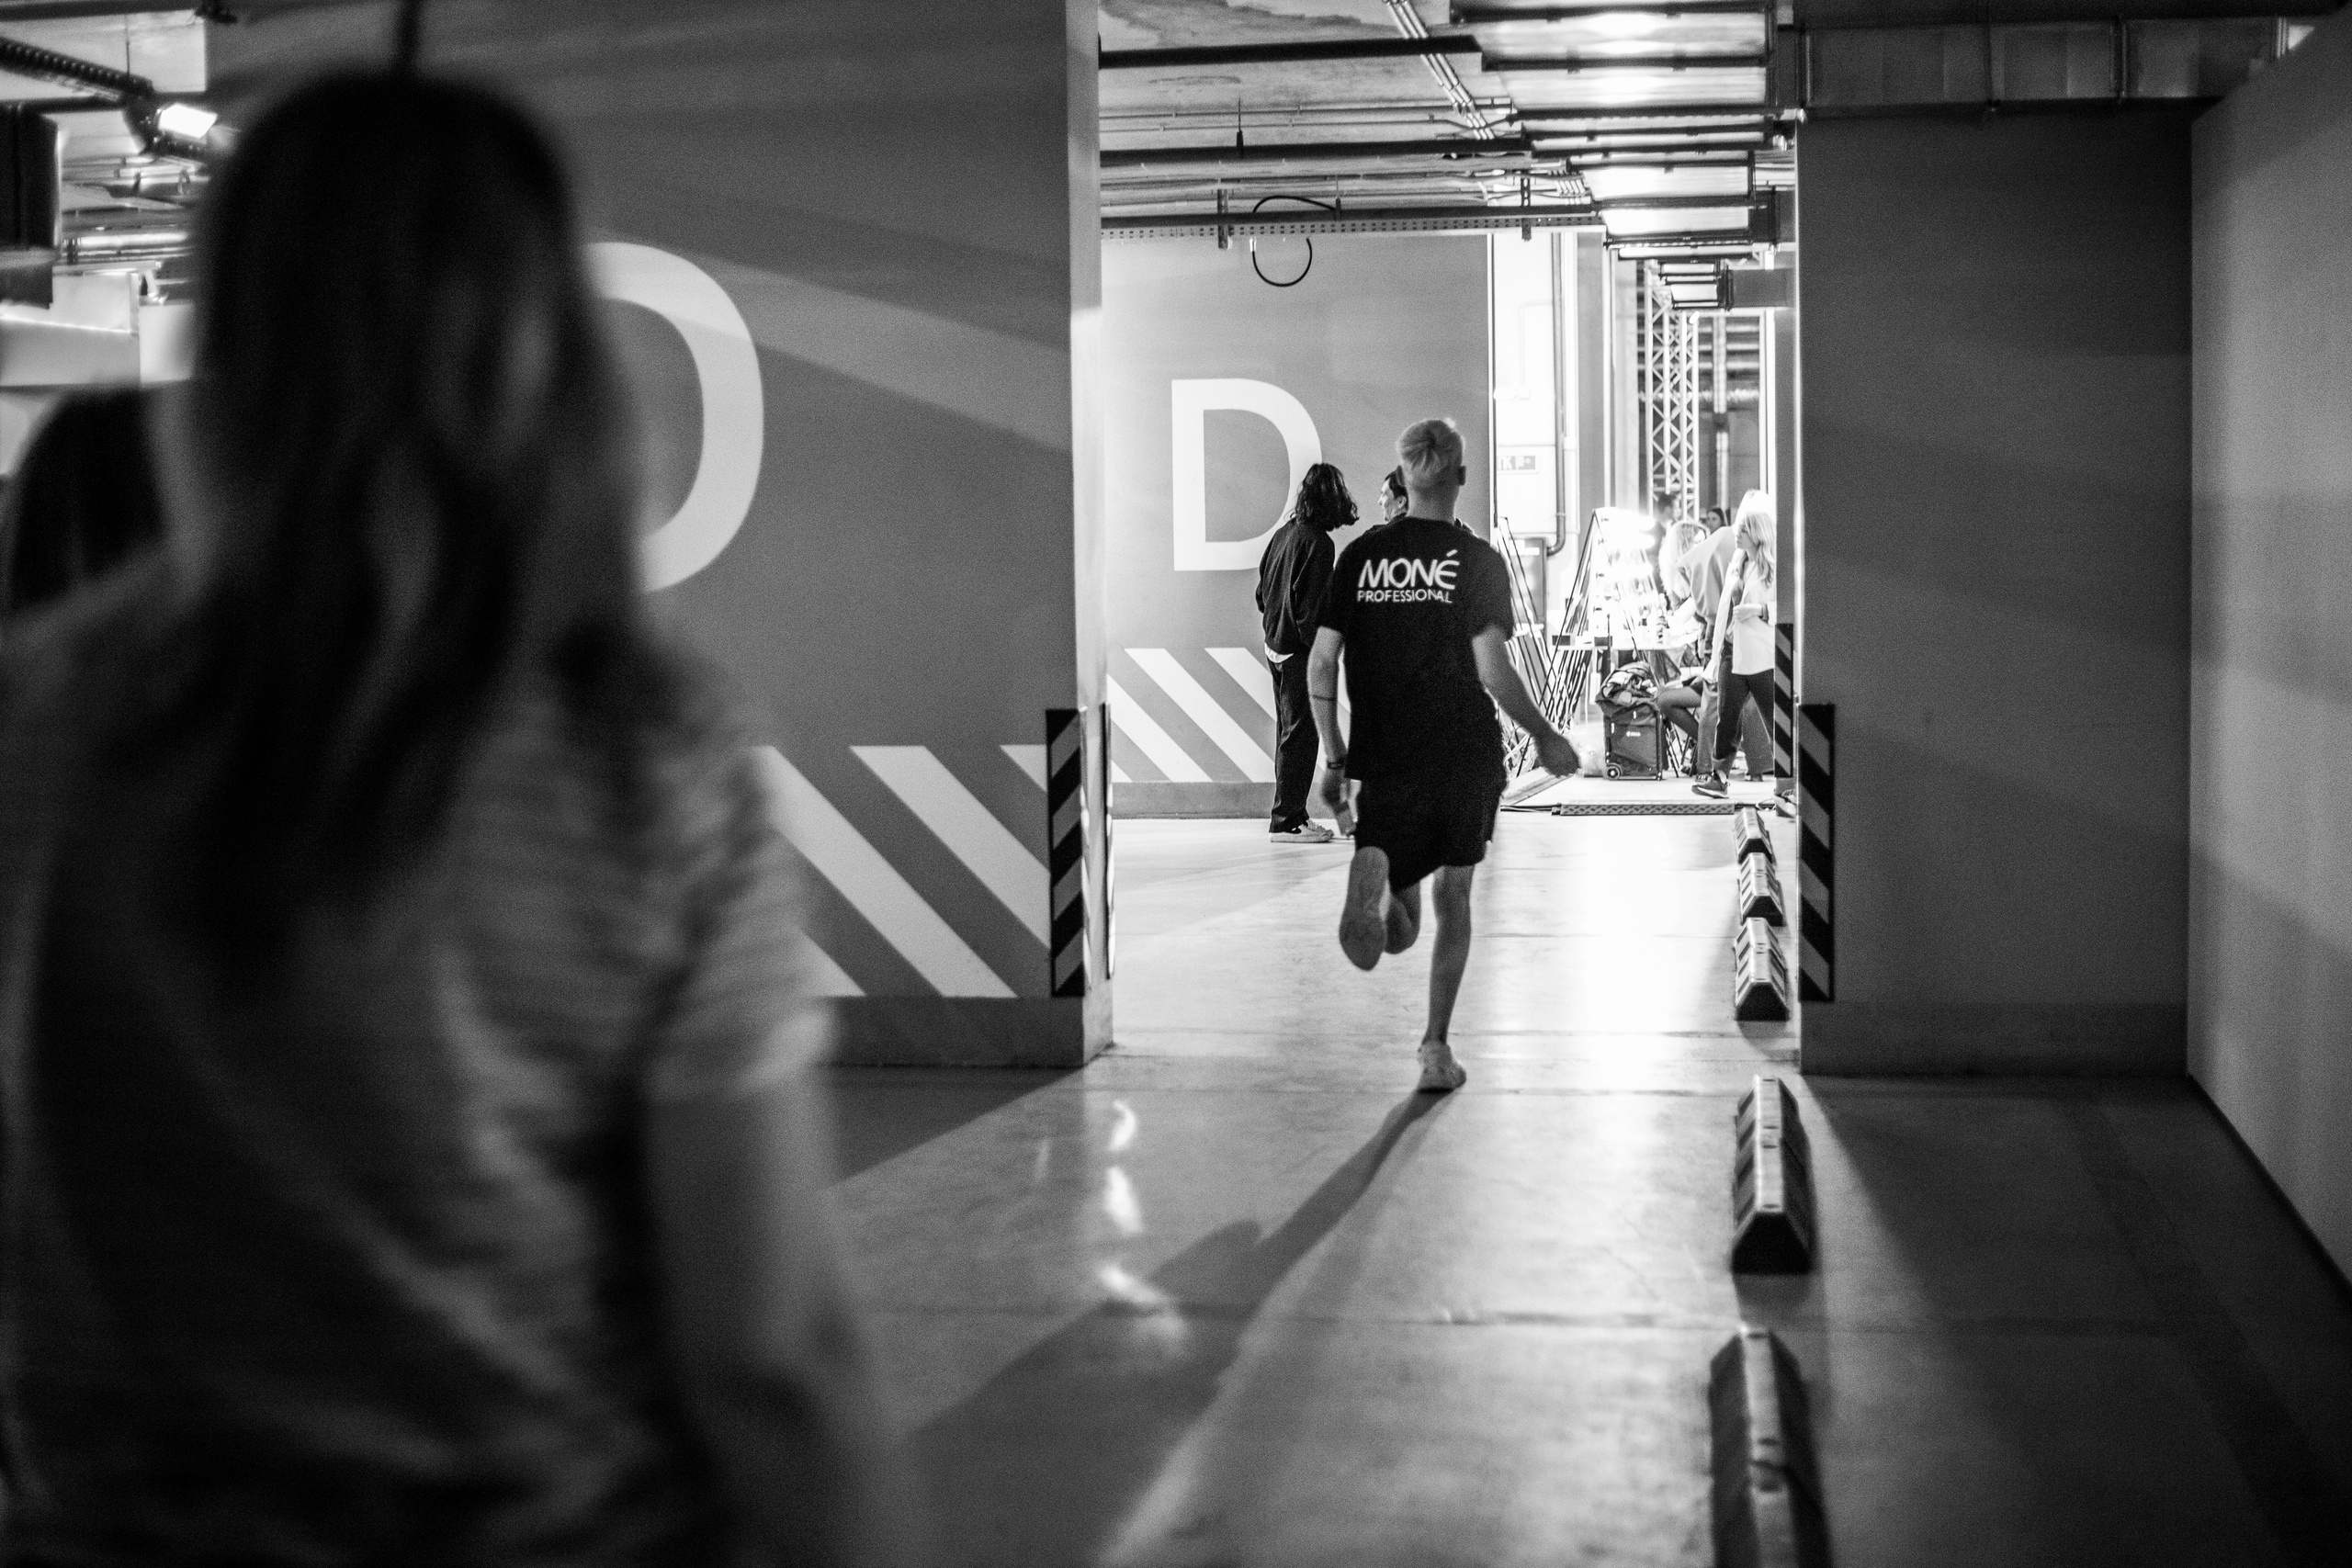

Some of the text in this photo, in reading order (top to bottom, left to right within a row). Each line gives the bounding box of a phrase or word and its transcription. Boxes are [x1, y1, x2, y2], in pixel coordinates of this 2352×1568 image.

[1171, 378, 1322, 570] D
[1358, 549, 1460, 590] MONÉ
[1357, 589, 1453, 604] PROFESSIONAL
